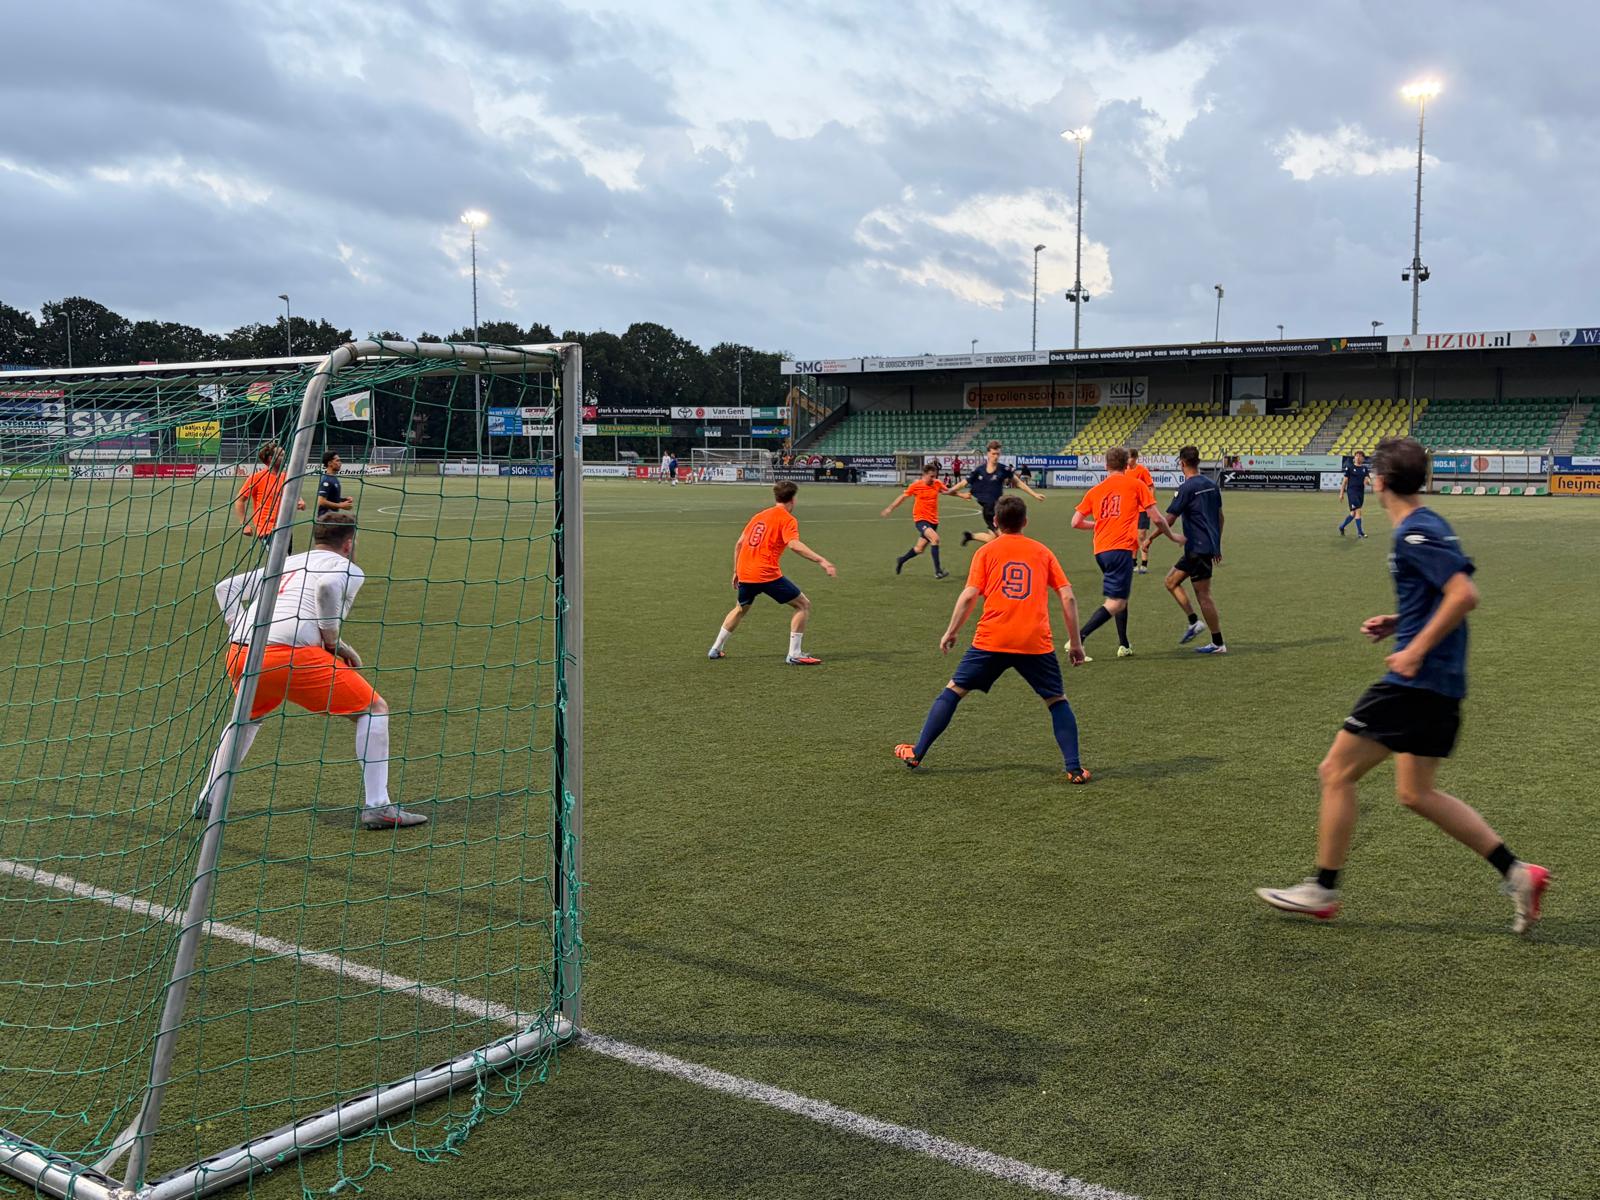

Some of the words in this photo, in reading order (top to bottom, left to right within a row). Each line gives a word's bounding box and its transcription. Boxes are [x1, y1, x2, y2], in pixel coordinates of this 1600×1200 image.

[1426, 333, 1512, 349] HZ101.nl
[1582, 329, 1600, 344] W
[1050, 353, 1065, 362] Ook
[1066, 353, 1090, 362] tijdens
[1100, 350, 1135, 361] wedstrijd
[1135, 350, 1152, 361] gaat
[1153, 350, 1168, 359] ons
[1169, 348, 1189, 357] werk
[1191, 347, 1223, 357] gewoon
[1223, 345, 1243, 354] door.
[1245, 343, 1319, 353] www.teeuwissen.com
[795, 361, 824, 374] SMG
[1109, 382, 1146, 397] KING
[619, 406, 670, 416] vloerverwijdering
[712, 407, 726, 415] Van
[727, 407, 745, 415] Gent
[1017, 456, 1047, 465] Maxima
[1055, 473, 1093, 483] Knipmeijer
[1001, 561, 1032, 600] 9
